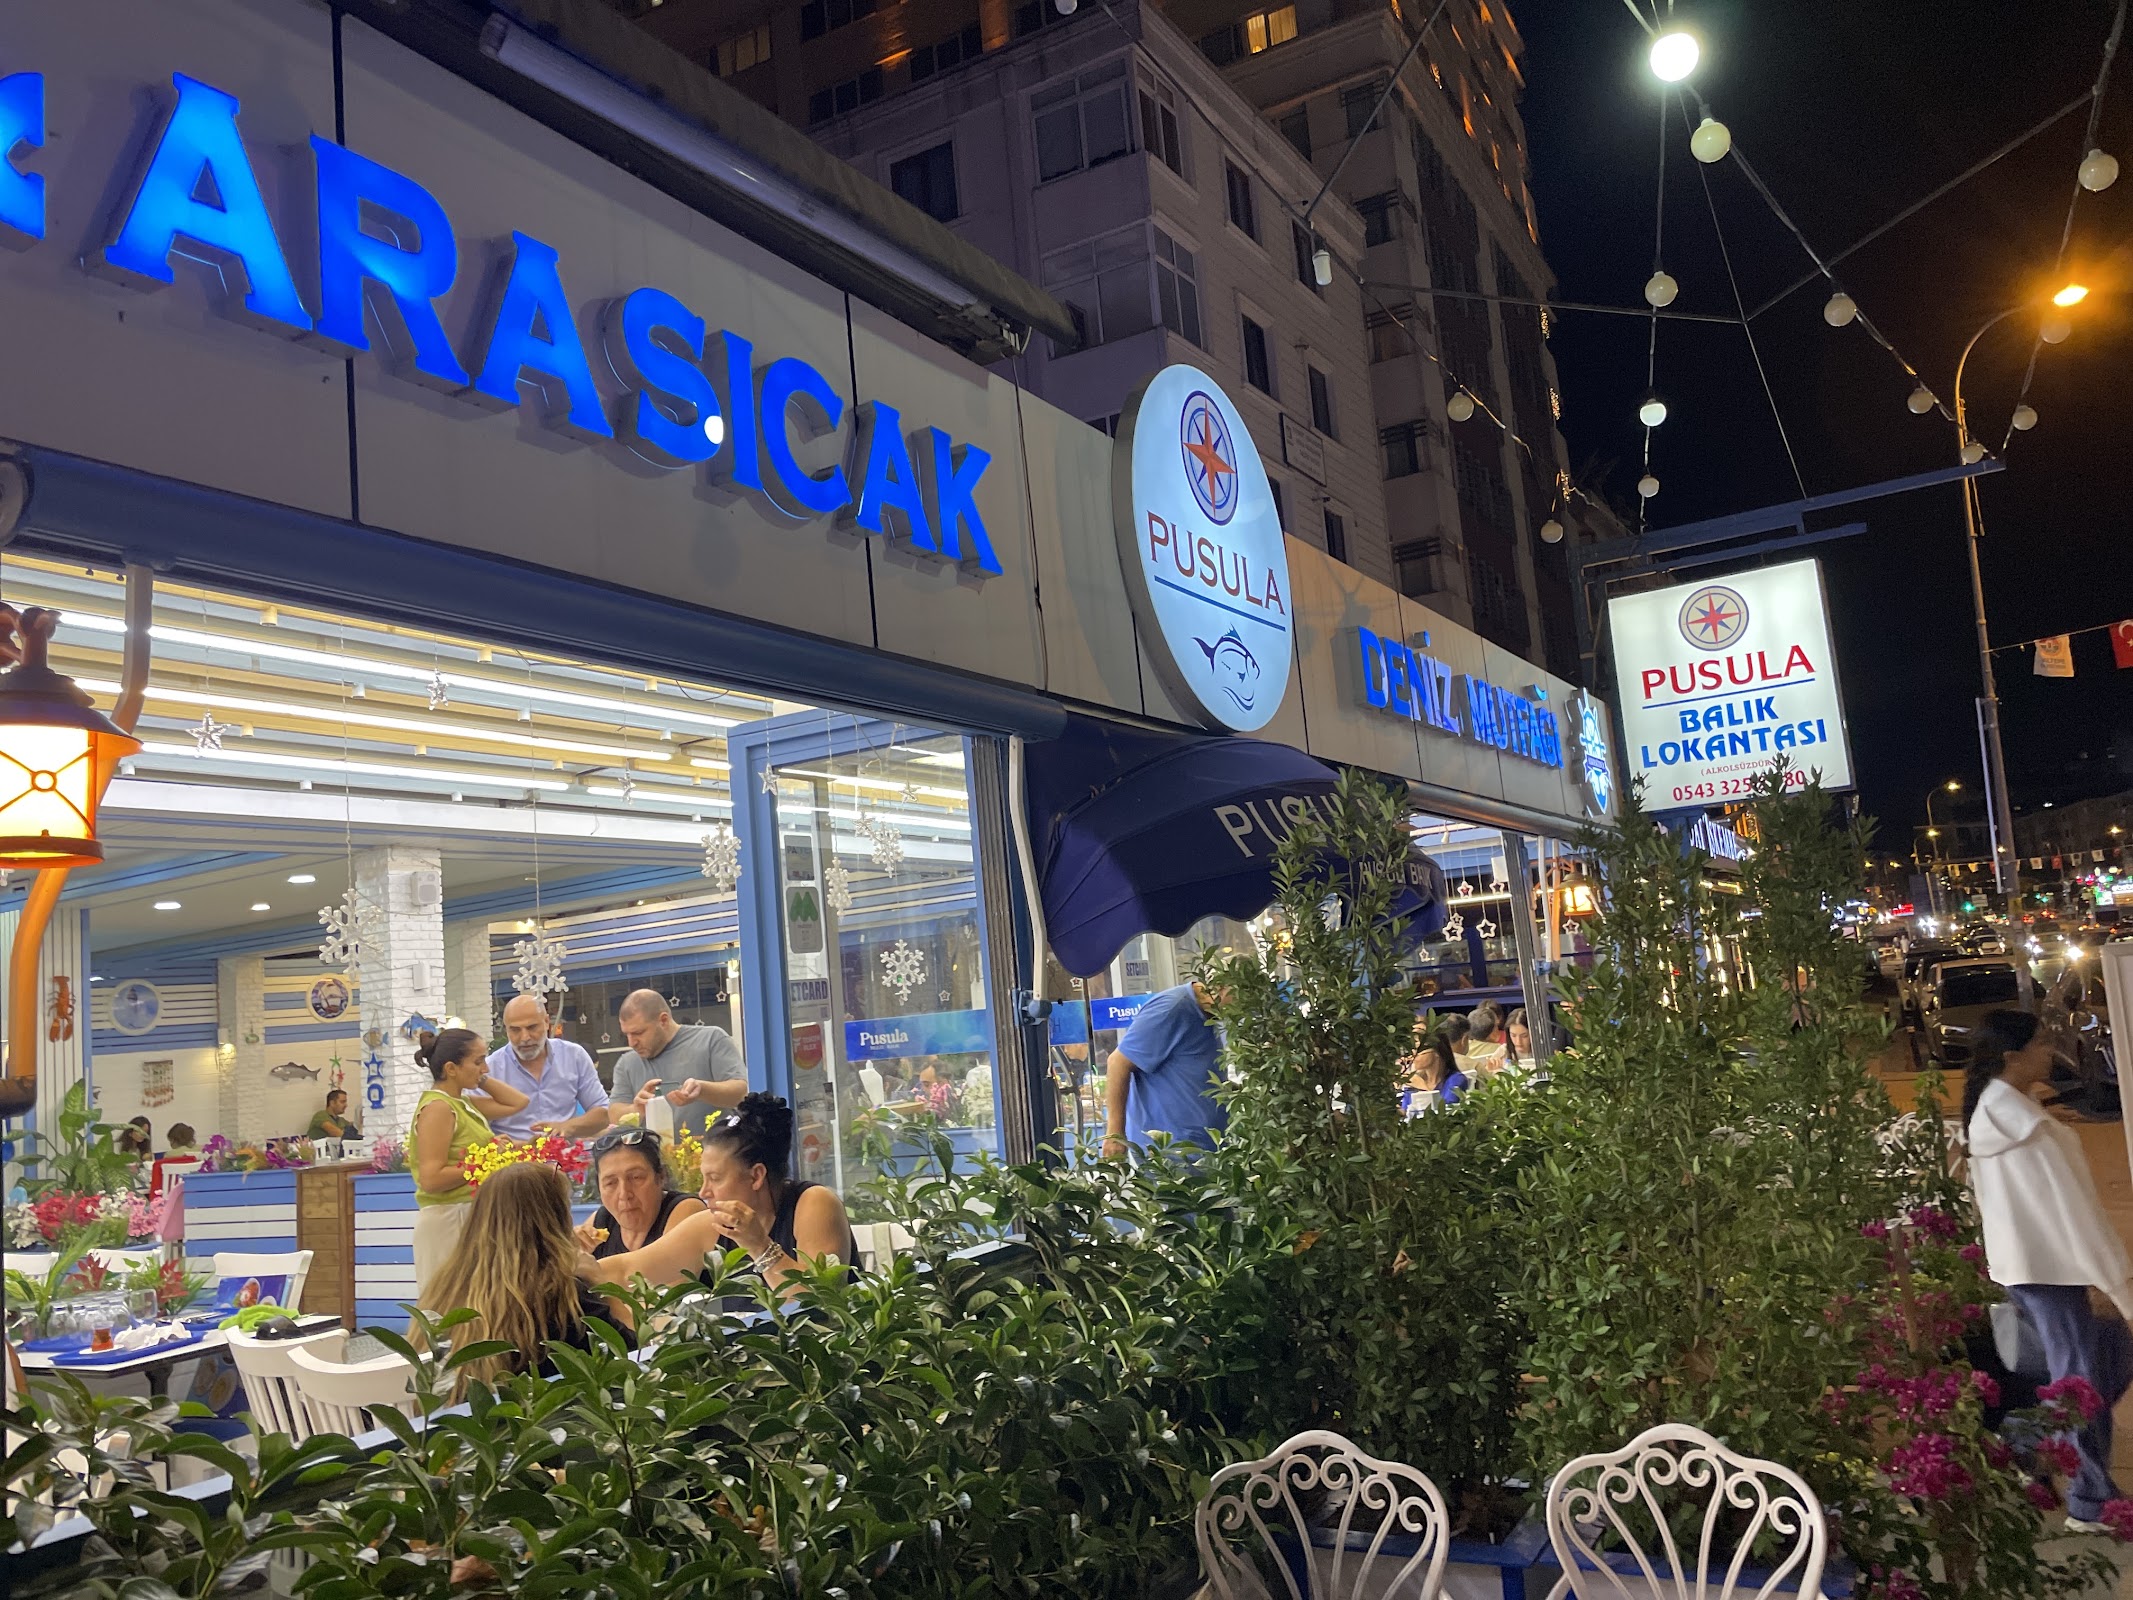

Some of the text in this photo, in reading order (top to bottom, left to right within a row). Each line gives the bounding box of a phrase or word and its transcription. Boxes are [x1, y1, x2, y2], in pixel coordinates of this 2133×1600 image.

[106, 72, 1001, 576] ARASICAK
[1147, 510, 1286, 616] PUSULA
[1641, 644, 1816, 700] PUSULA
[1358, 626, 1564, 769] DENİZ MUTFAĞI
[1679, 696, 1779, 734] BALIK
[1641, 718, 1828, 769] LOKANTASI
[1672, 781, 1716, 802] 0543
[1721, 778, 1753, 795] 325
[791, 980, 828, 1002] ETCARD
[1109, 1003, 1141, 1018] Pusul
[860, 1028, 909, 1046] Pusula
